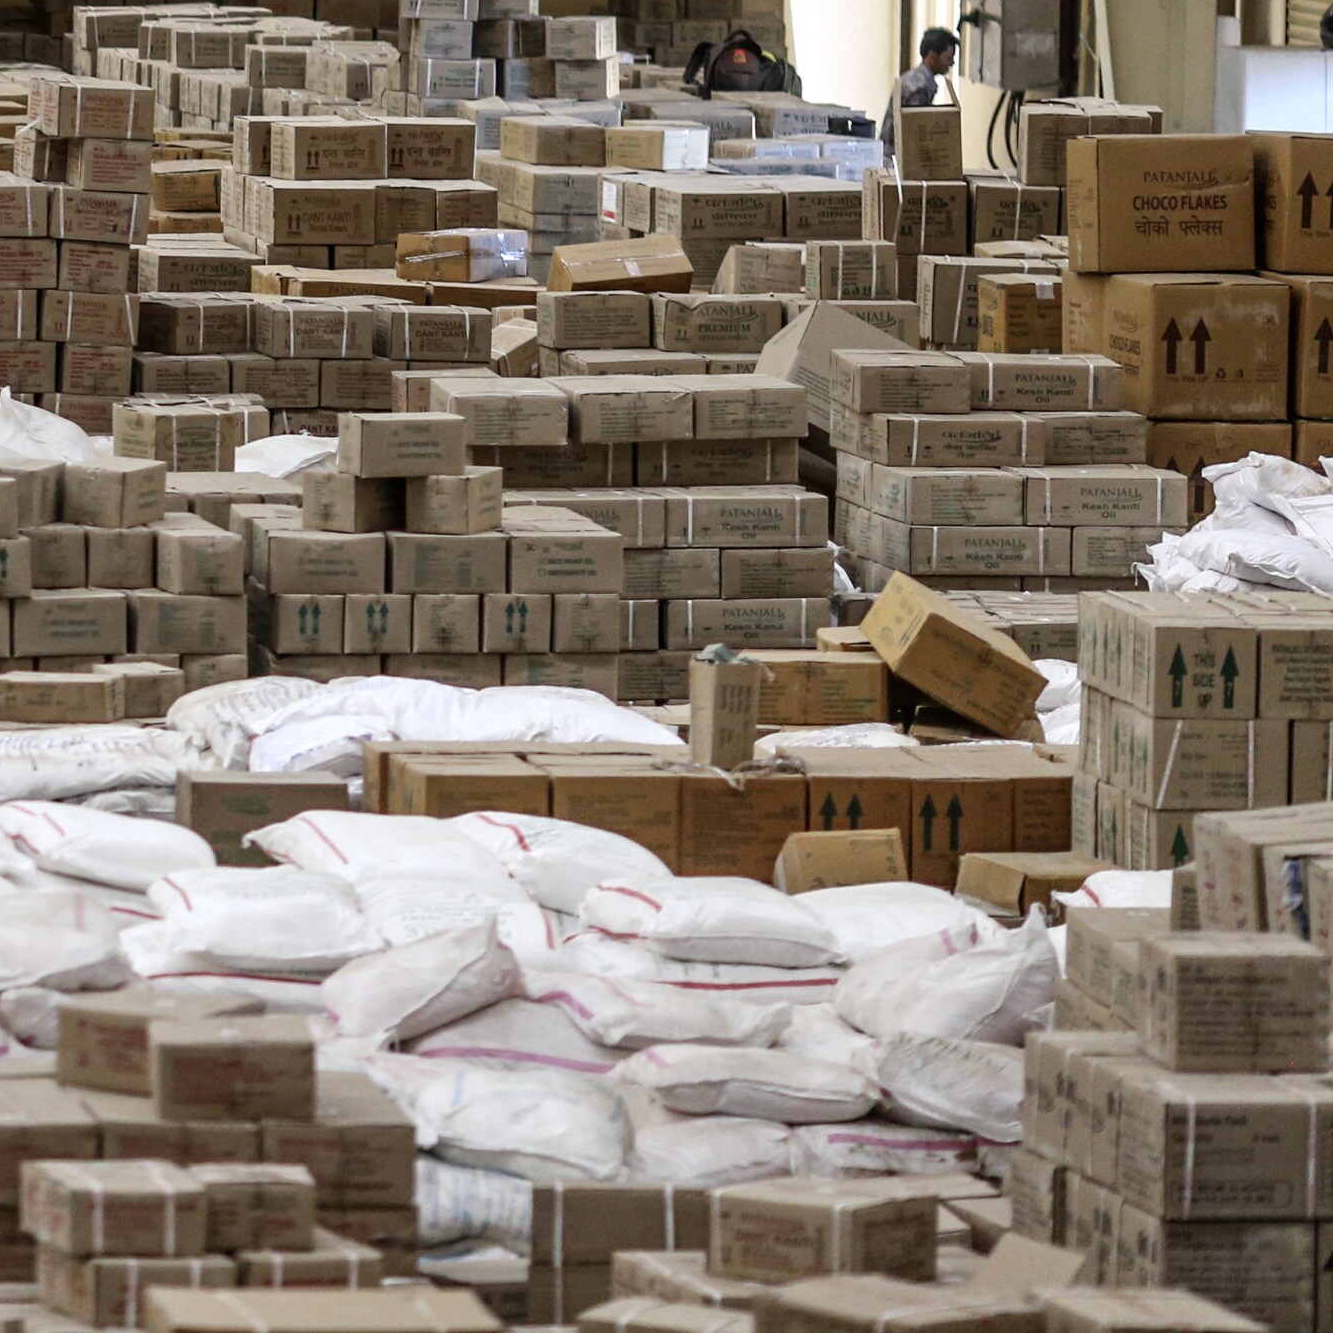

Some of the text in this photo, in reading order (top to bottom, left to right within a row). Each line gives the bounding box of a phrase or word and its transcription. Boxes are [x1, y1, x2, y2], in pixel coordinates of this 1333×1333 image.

[1144, 171, 1218, 188] PATANJALI
[1133, 195, 1227, 211] CHOCO FLAKES
[1135, 215, 1223, 236] चोको फ्लेक्स
[698, 323, 751, 333] PREMIUM
[1015, 373, 1077, 385] PATANJALI
[1016, 388, 1074, 396] Kesh Kanti
[1035, 396, 1050, 404] Oil
[1081, 488, 1142, 500] PATANJALI
[1082, 502, 1140, 511] Kesh Kanti
[720, 508, 783, 520] PATANJALI
[1101, 511, 1116, 519] Oil
[965, 537, 1027, 549] PATANJALI
[966, 553, 1023, 561] Kesh Kanti
[985, 562, 1000, 570] Oil
[723, 607, 786, 619] PATANJALI
[1193, 653, 1215, 667] THIS
[1193, 674, 1215, 687] SIDE
[1197, 693, 1212, 706] UP
